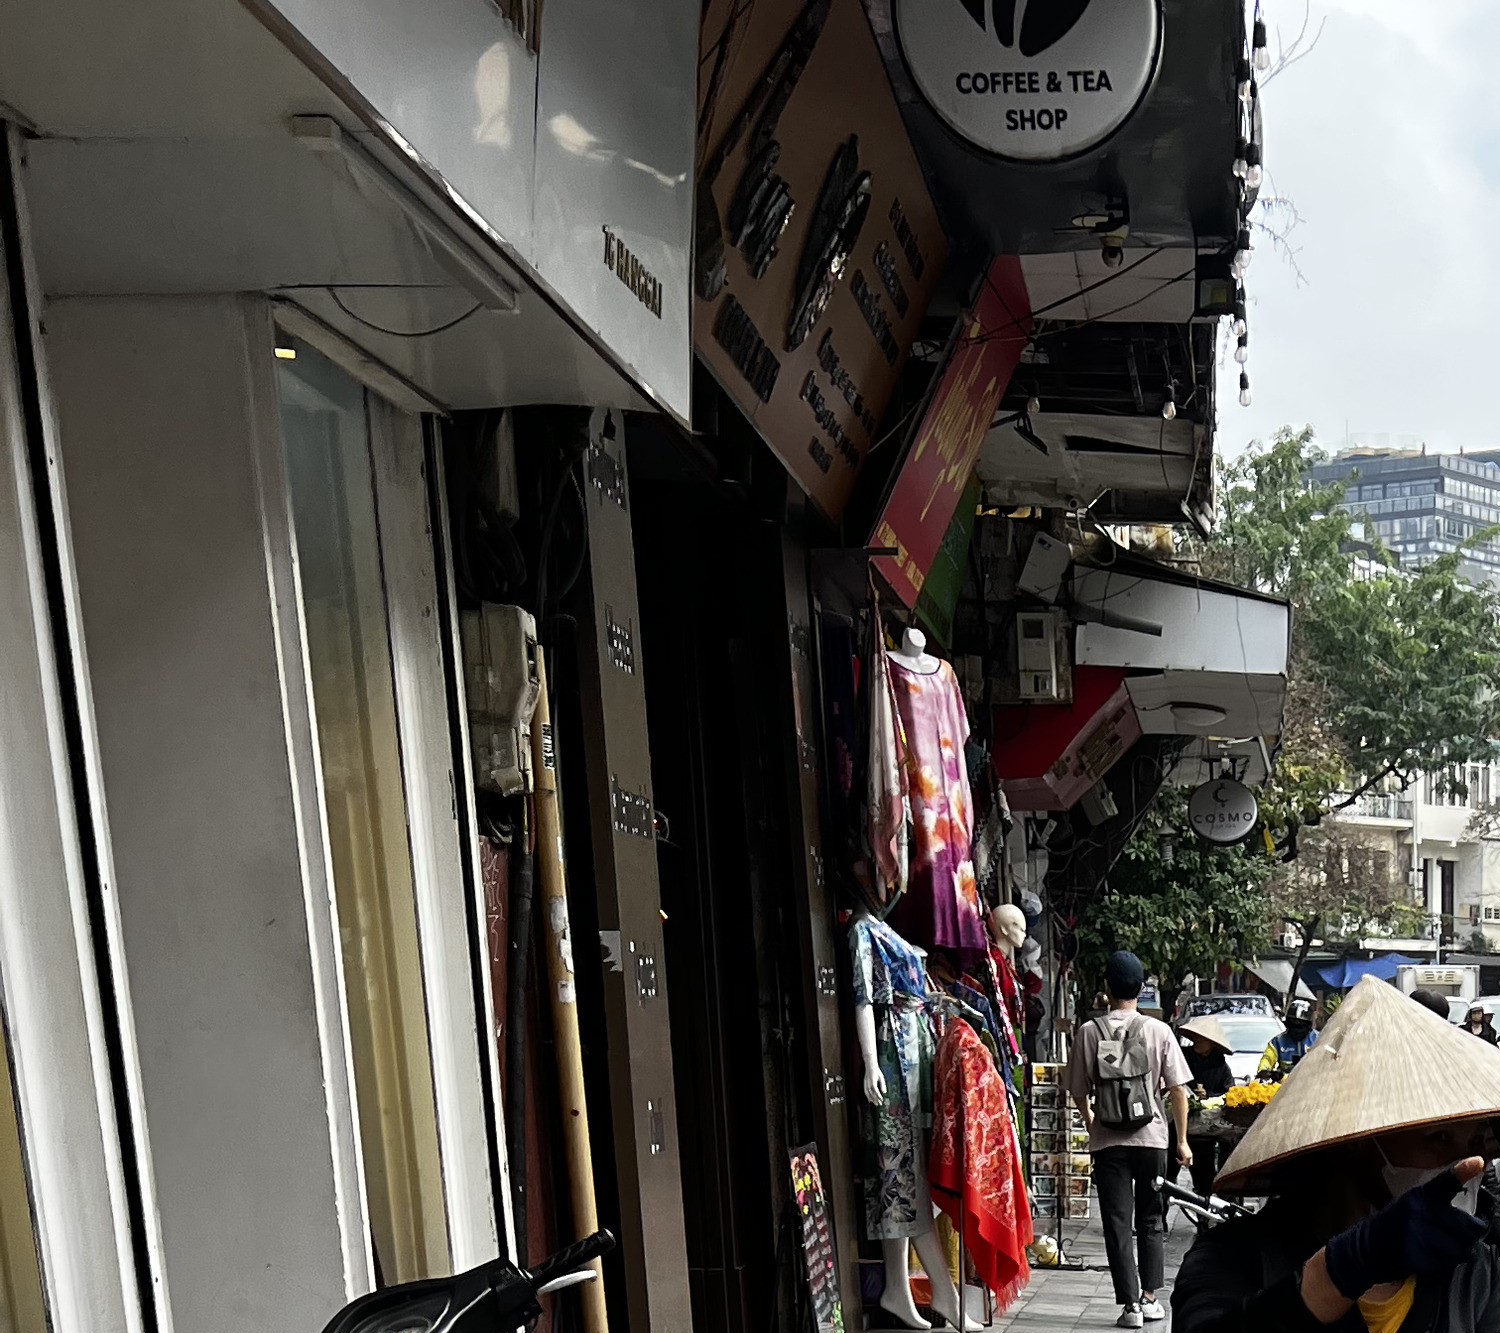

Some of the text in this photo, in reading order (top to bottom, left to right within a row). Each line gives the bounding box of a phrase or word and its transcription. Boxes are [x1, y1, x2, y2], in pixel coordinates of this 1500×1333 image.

[956, 69, 1113, 95] COFFEE & TEA
[1005, 108, 1069, 131] SHOP
[1194, 812, 1253, 823] COSMO
